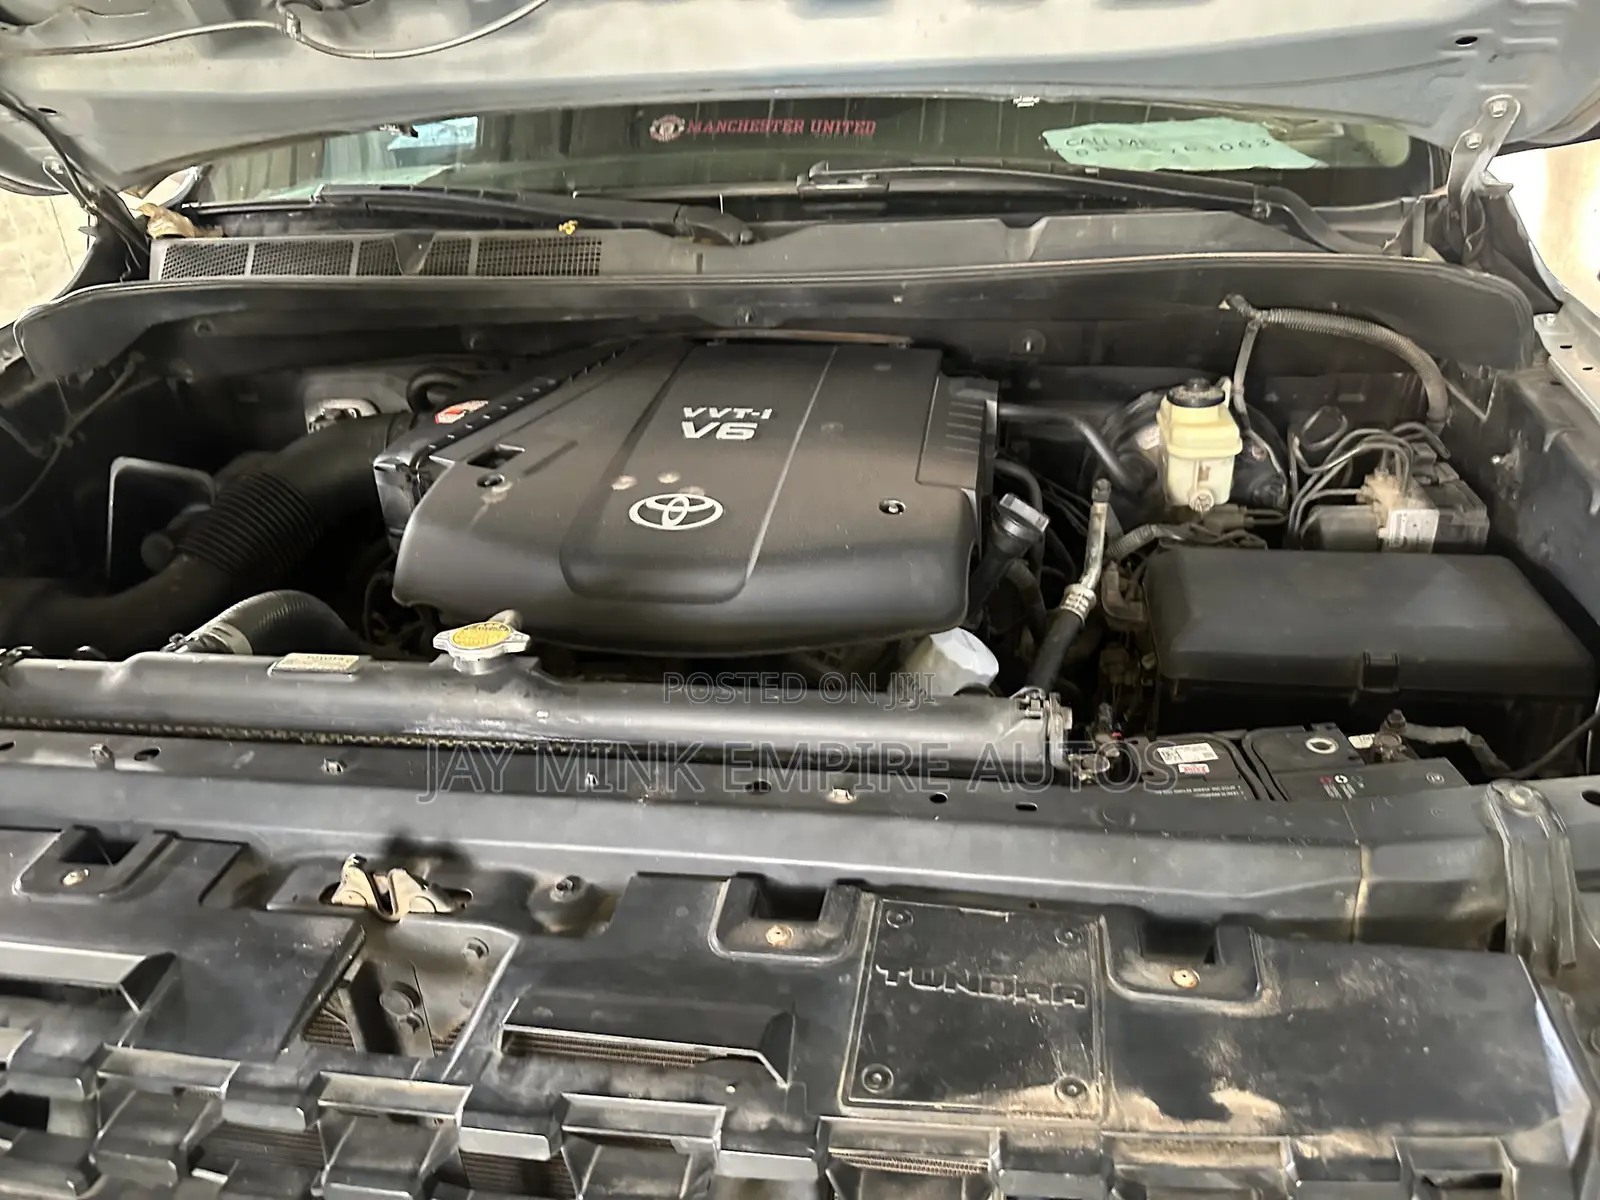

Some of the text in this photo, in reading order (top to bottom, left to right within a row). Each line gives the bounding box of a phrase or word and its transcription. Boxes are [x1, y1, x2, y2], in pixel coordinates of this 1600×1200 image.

[686, 118, 804, 134] MANCHESTER
[810, 118, 876, 136] UNITED
[681, 421, 758, 440] V6
[875, 962, 1087, 1009] TUNDRA
